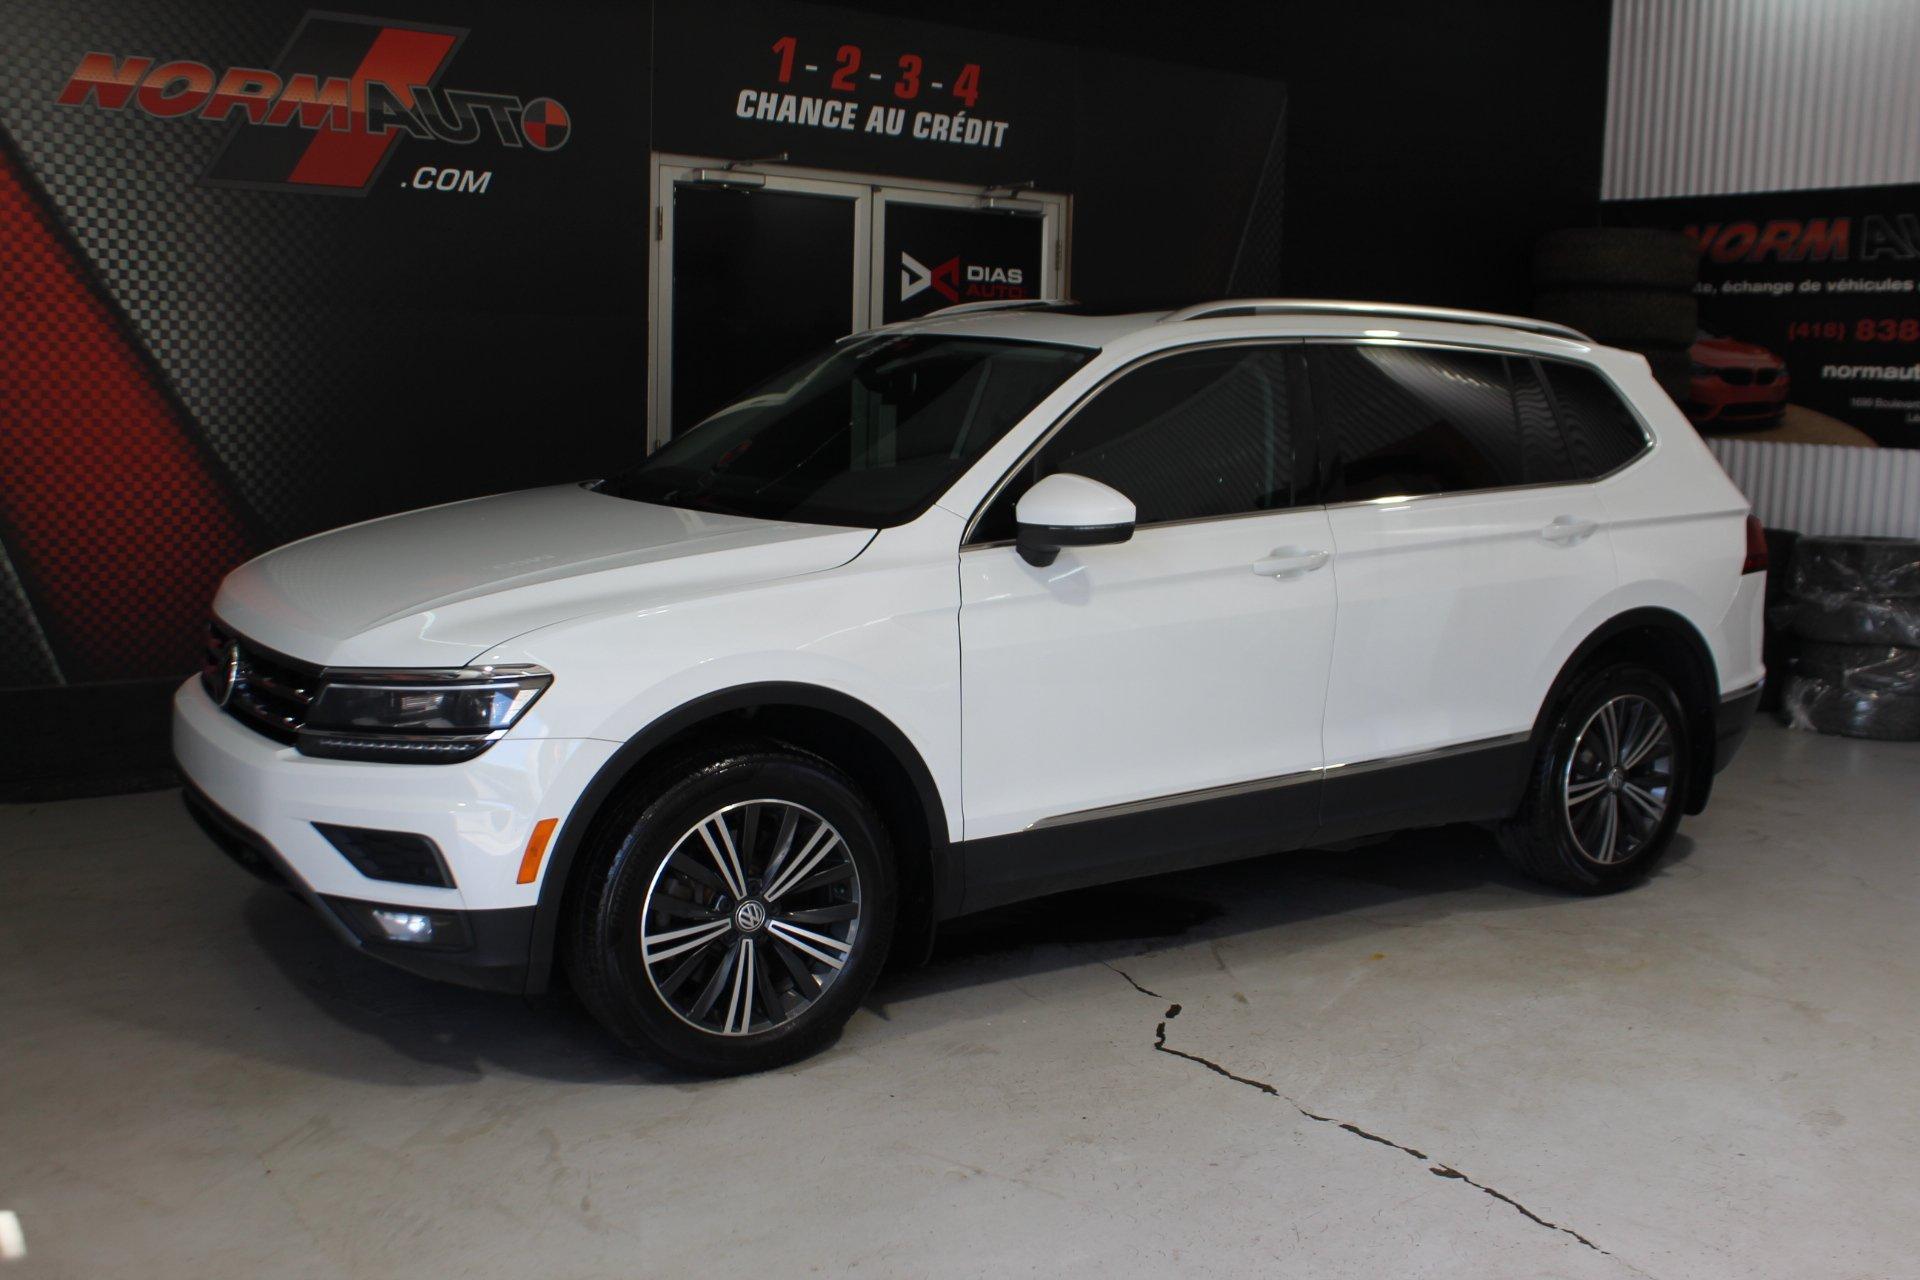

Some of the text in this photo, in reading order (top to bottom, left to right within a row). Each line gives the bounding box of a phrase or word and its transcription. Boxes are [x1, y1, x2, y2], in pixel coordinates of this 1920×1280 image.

[736, 89, 1009, 148] CHANCE AU CRÉDIT
[966, 265, 1023, 284] DIAS
[1721, 279, 1795, 297] échange
[1798, 278, 1822, 294] de
[1826, 277, 1915, 294] véhicules
